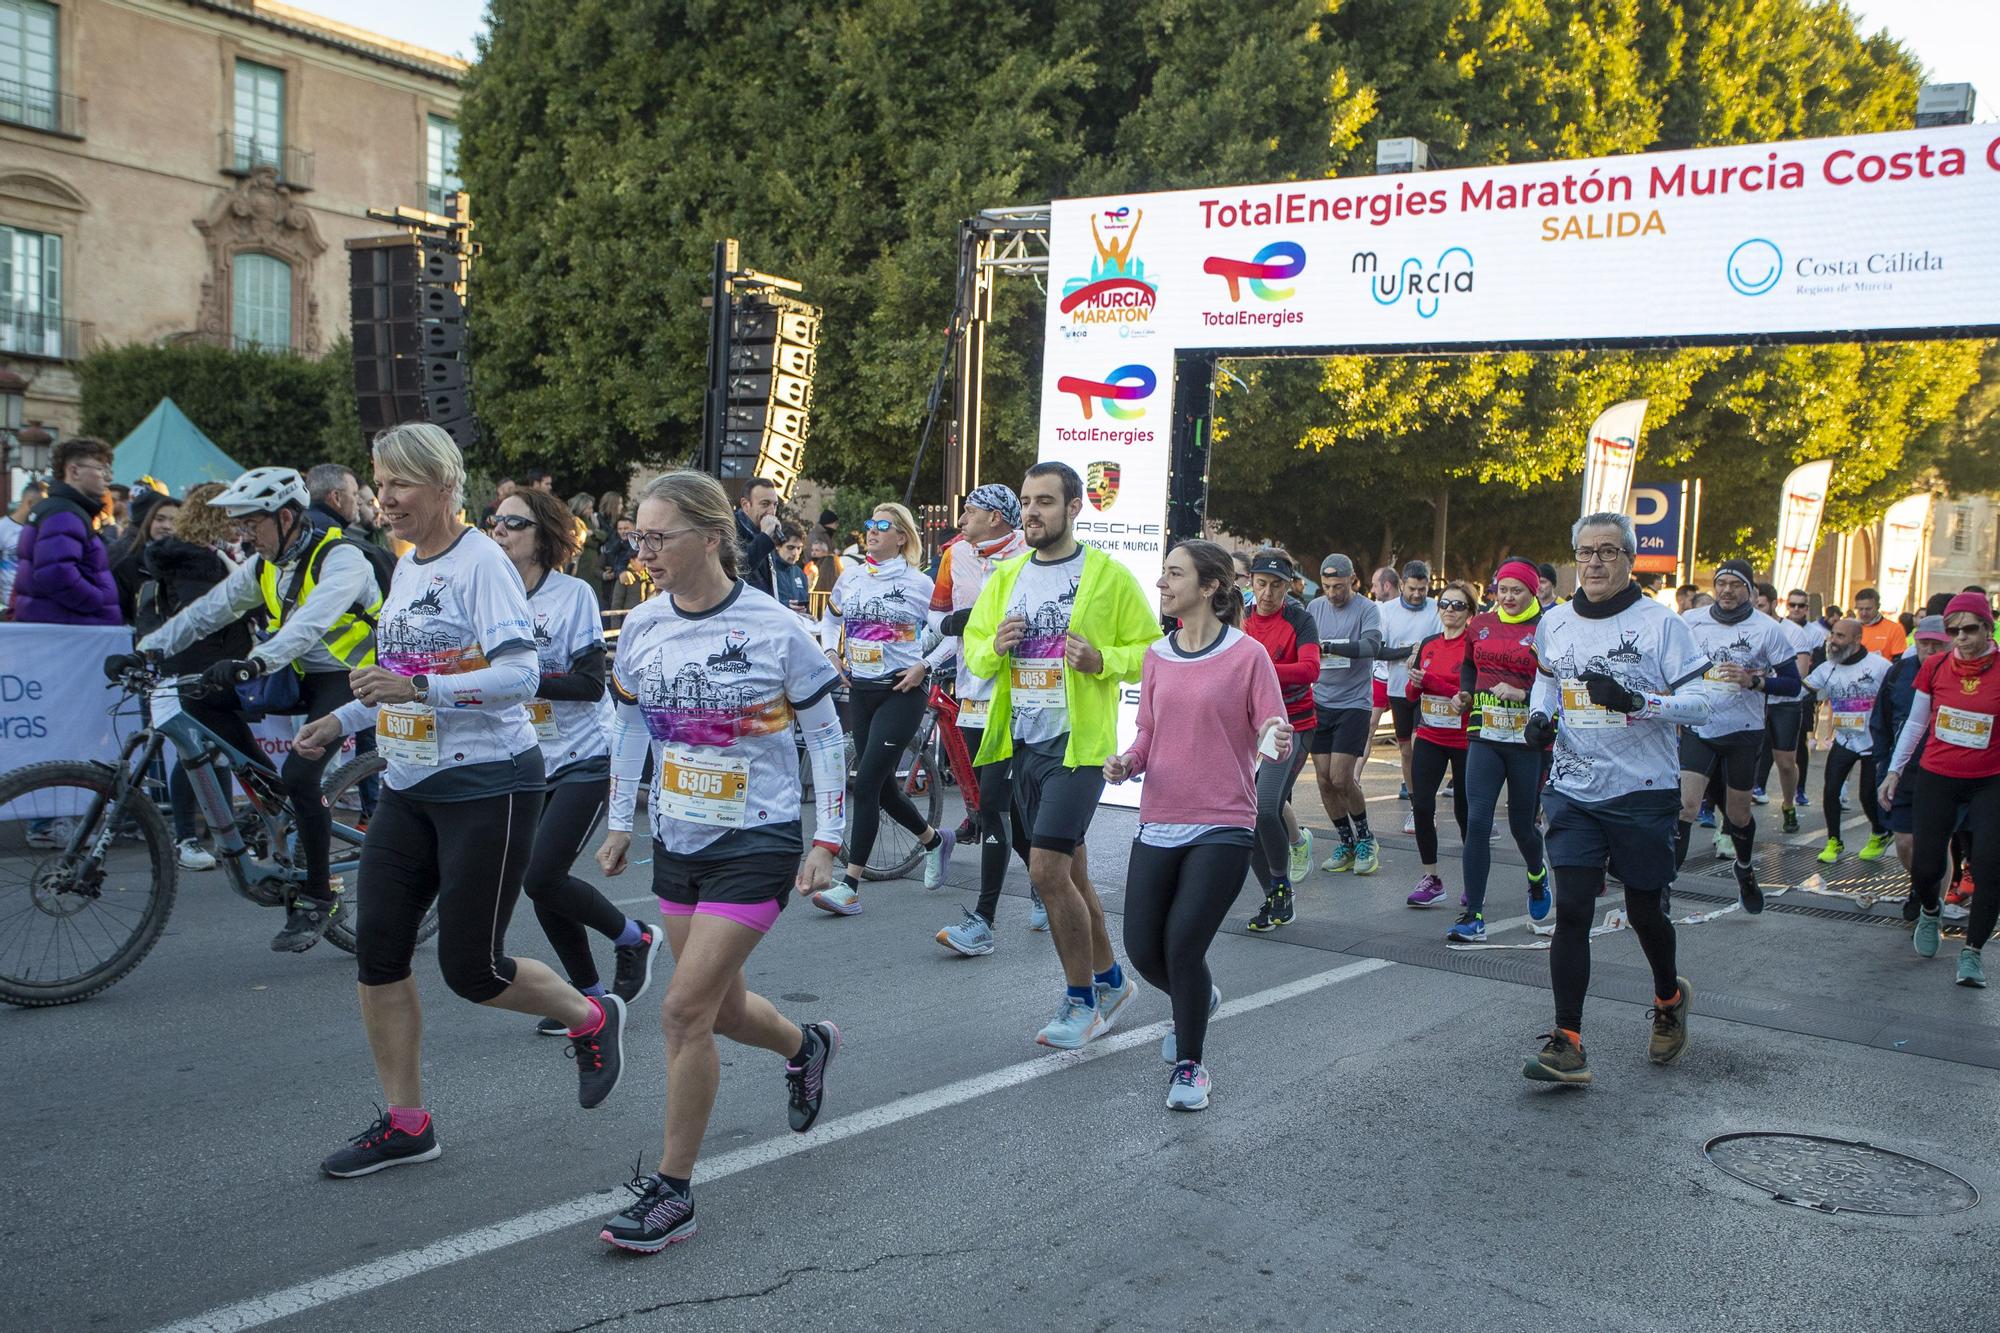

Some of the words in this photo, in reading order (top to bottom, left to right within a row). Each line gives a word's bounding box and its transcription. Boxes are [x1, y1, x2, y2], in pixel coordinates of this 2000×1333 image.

[1199, 183, 1447, 228] TotalEnergies
[1460, 167, 1632, 212] Maratón
[1649, 153, 1804, 199] Murcia
[1823, 145, 1965, 185] Costa
[1541, 210, 1666, 241] SALIDA
[1796, 257, 1858, 278] Costa
[1867, 250, 1945, 274] Cálida
[1087, 292, 1151, 308] MURCIA
[1202, 309, 1304, 328] TotalEnergies
[1056, 427, 1155, 445] TotalEnergies
[1072, 522, 1159, 535] RSCHE
[1123, 541, 1159, 552] MURCIA
[1640, 536, 1665, 548] 24h
[1, 675, 43, 702] De
[1020, 671, 1047, 686] 6053
[0, 715, 48, 739] ras
[387, 715, 415, 736] 6307
[678, 770, 723, 794] 6305
